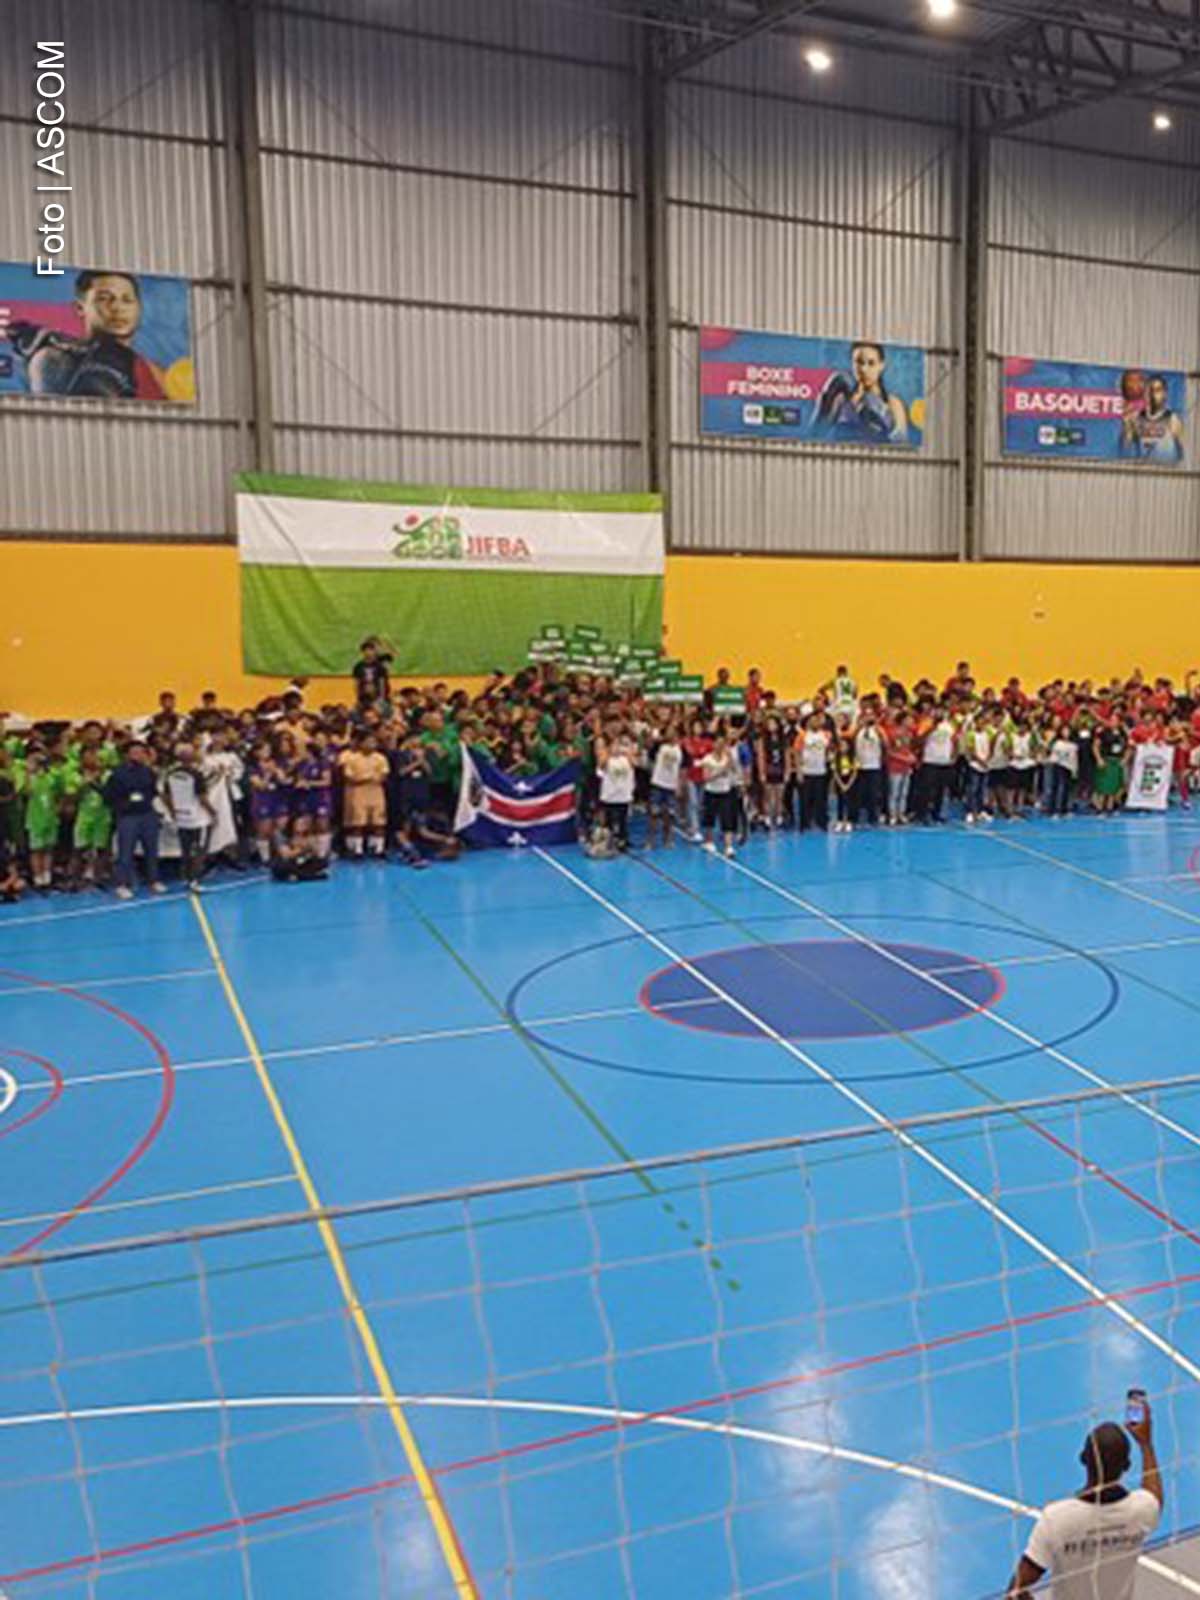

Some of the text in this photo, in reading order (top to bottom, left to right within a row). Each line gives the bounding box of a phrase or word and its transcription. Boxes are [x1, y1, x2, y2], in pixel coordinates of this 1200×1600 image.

[746, 366, 795, 381] BOXE
[727, 380, 812, 398] FEMININO
[1015, 392, 1124, 413] BASQUETE
[466, 536, 530, 556] JIFBA
